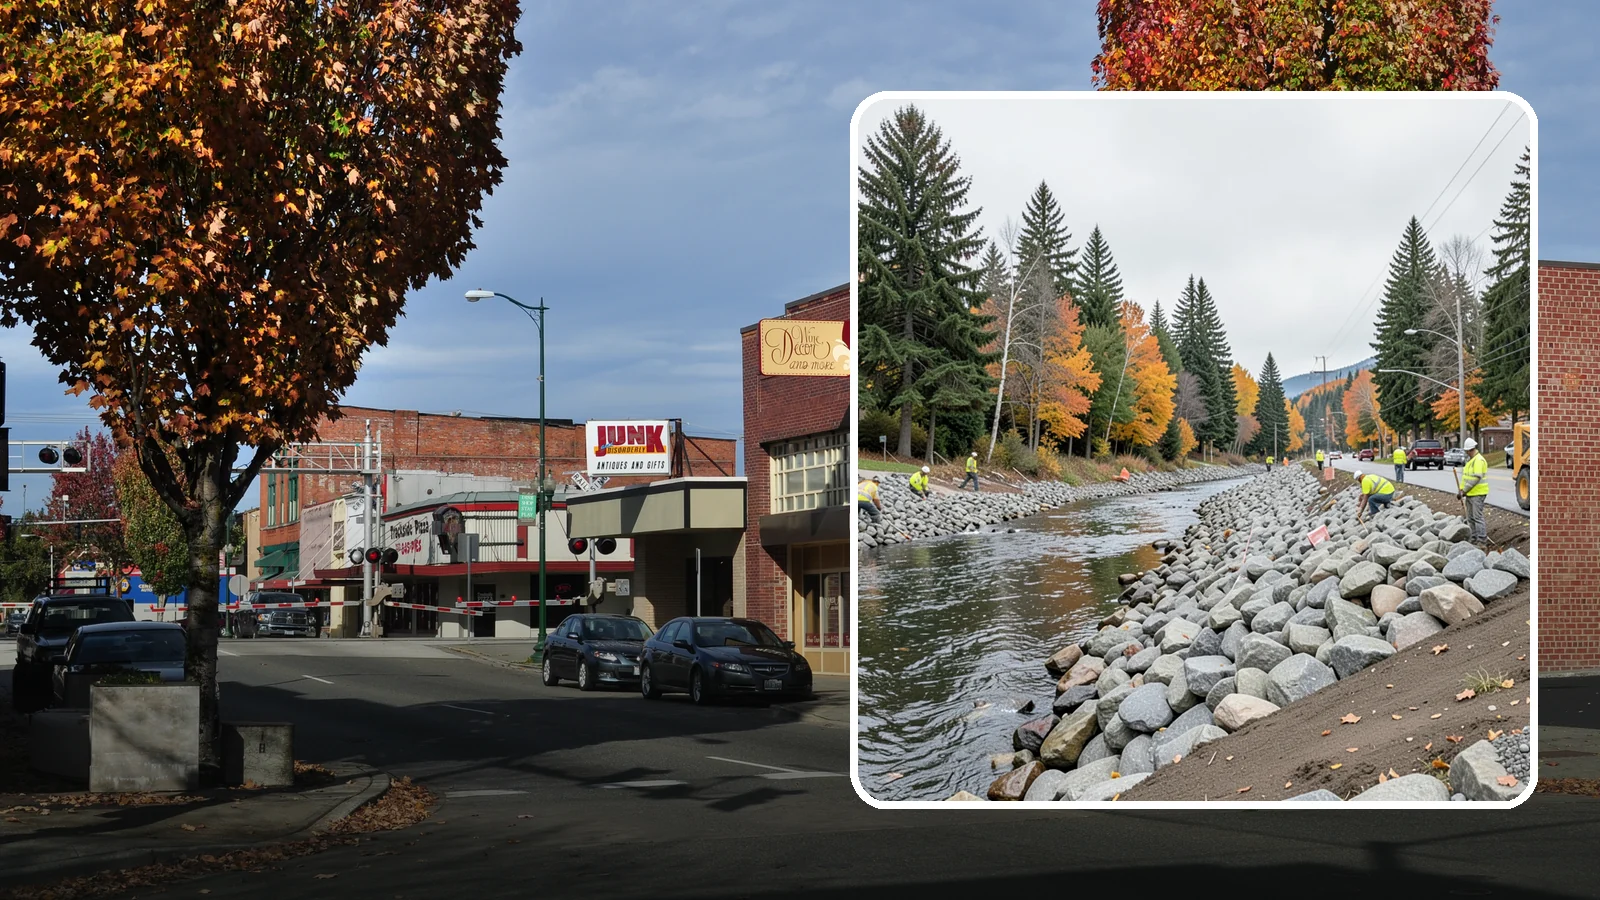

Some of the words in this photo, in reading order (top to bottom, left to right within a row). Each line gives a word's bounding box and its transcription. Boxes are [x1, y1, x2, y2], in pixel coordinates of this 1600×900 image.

[595, 425, 665, 457] JUNK
[607, 446, 646, 454] DISORDERLY
[597, 461, 628, 470] ANTIQUES
[631, 461, 643, 470] AND
[647, 460, 665, 469] GIFTS
[390, 521, 413, 539] Trackside
[415, 520, 429, 535] Pizza
